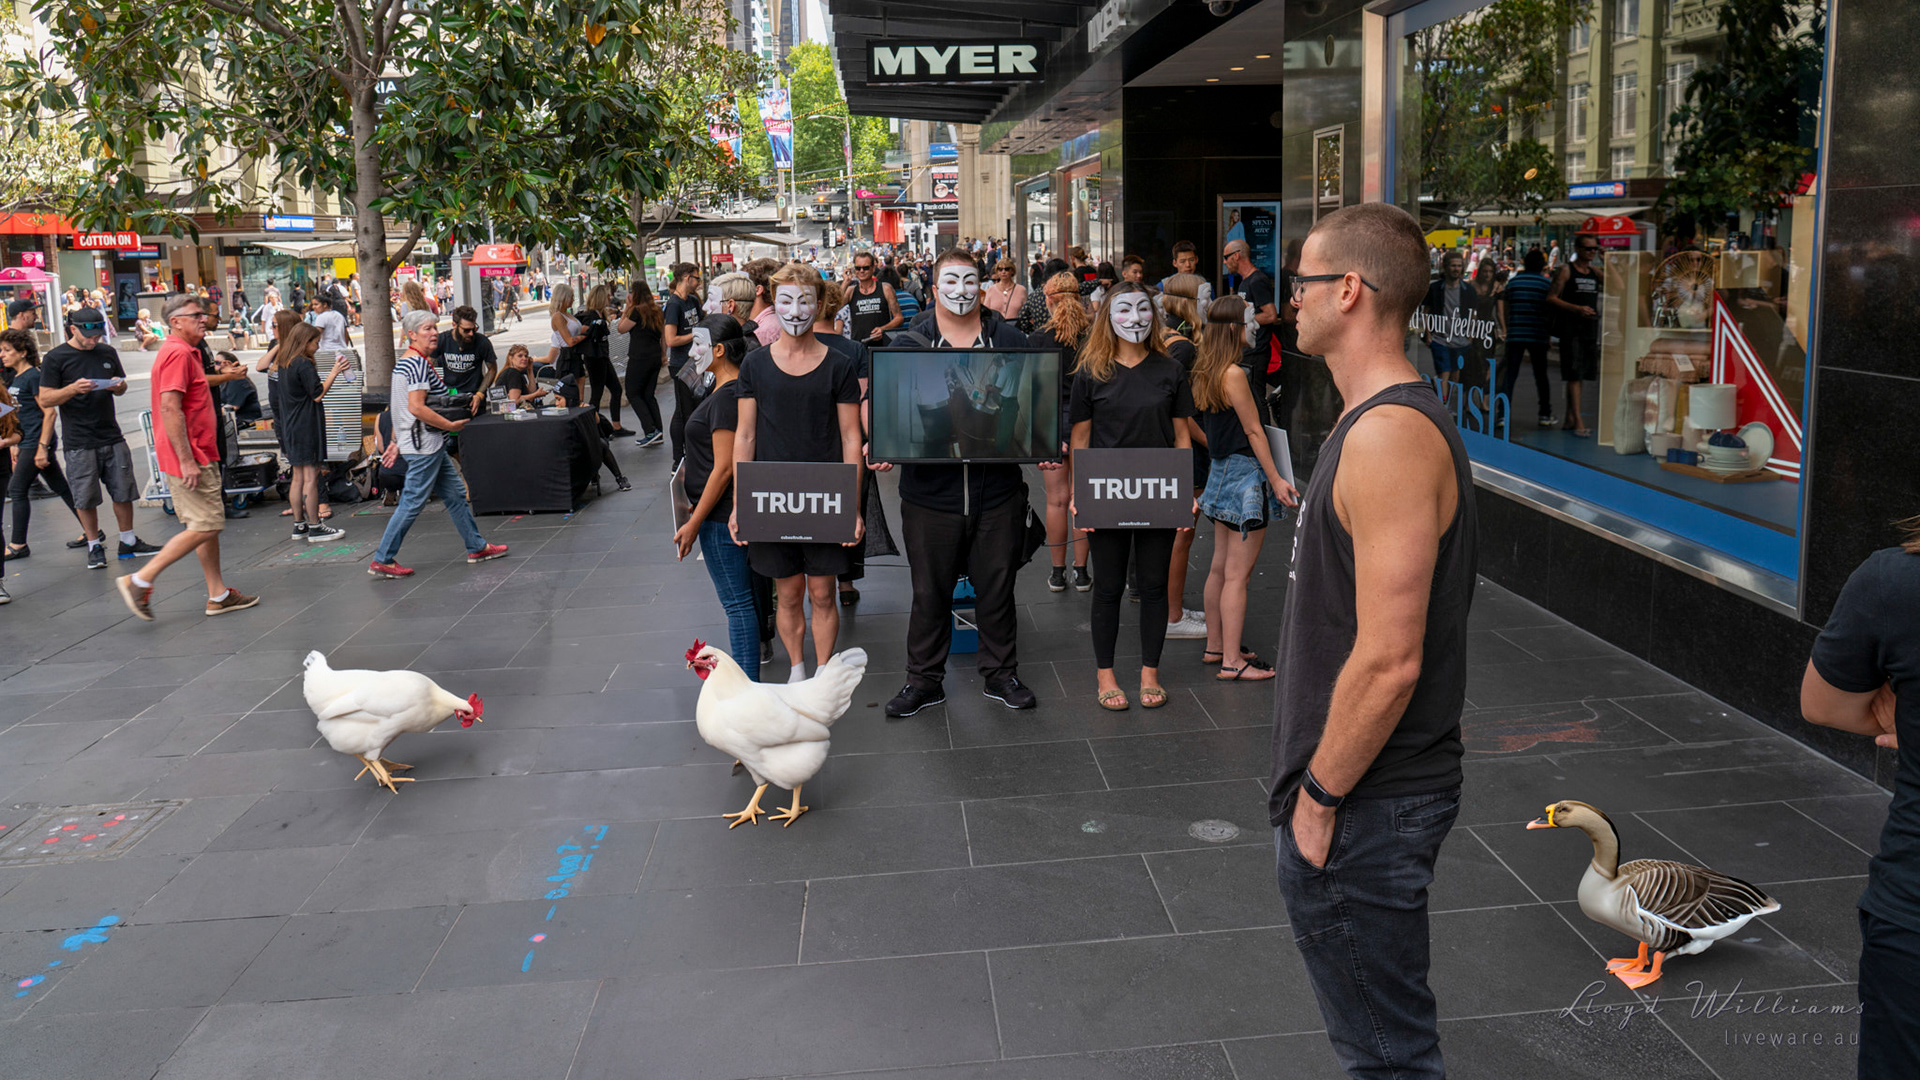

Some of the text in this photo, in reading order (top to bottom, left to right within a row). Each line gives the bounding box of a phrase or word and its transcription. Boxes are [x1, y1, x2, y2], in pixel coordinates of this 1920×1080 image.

[874, 45, 1038, 75] MYER
[79, 234, 117, 247] COTTON
[118, 234, 131, 245] ON
[1420, 305, 1448, 338] your
[1446, 307, 1495, 349] feeling
[1088, 478, 1179, 500] TRUTH
[751, 491, 842, 515] TRUTH
